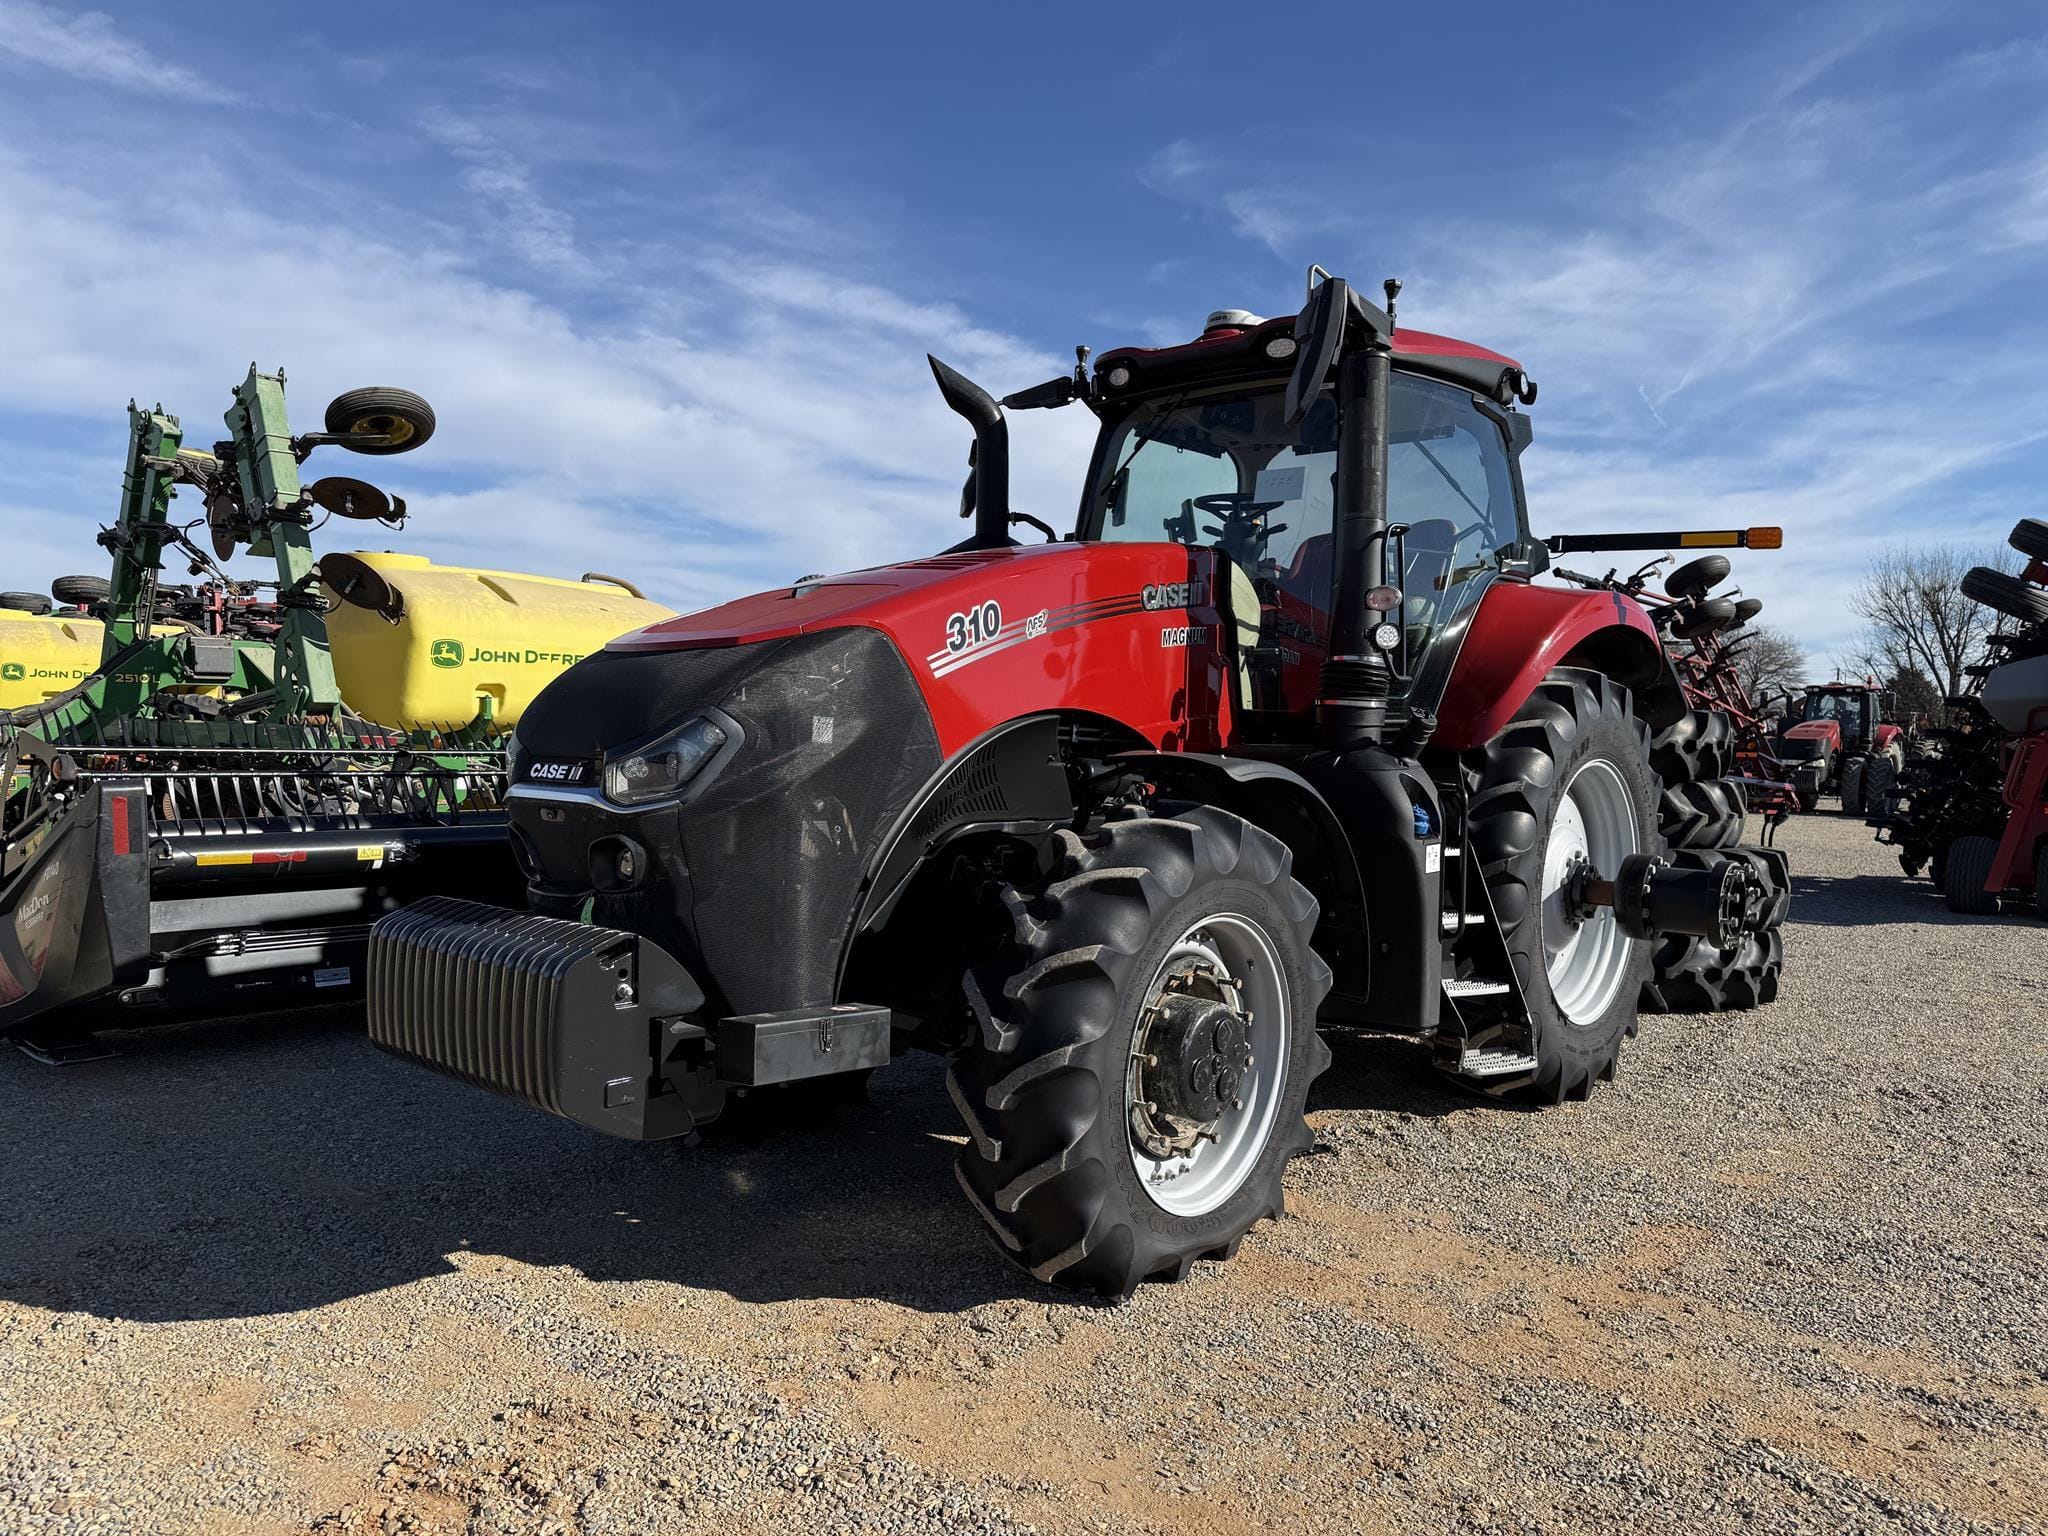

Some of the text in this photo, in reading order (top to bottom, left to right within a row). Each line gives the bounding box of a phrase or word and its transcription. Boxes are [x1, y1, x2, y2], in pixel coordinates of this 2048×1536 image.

[1141, 582, 1188, 611] CASE
[946, 599, 1002, 656] 310
[1027, 613, 1045, 632] AFS
[1161, 626, 1207, 648] MAGNUM
[469, 647, 520, 663] JOHN
[29, 668, 69, 679] JOHN
[530, 763, 568, 779] CASE
